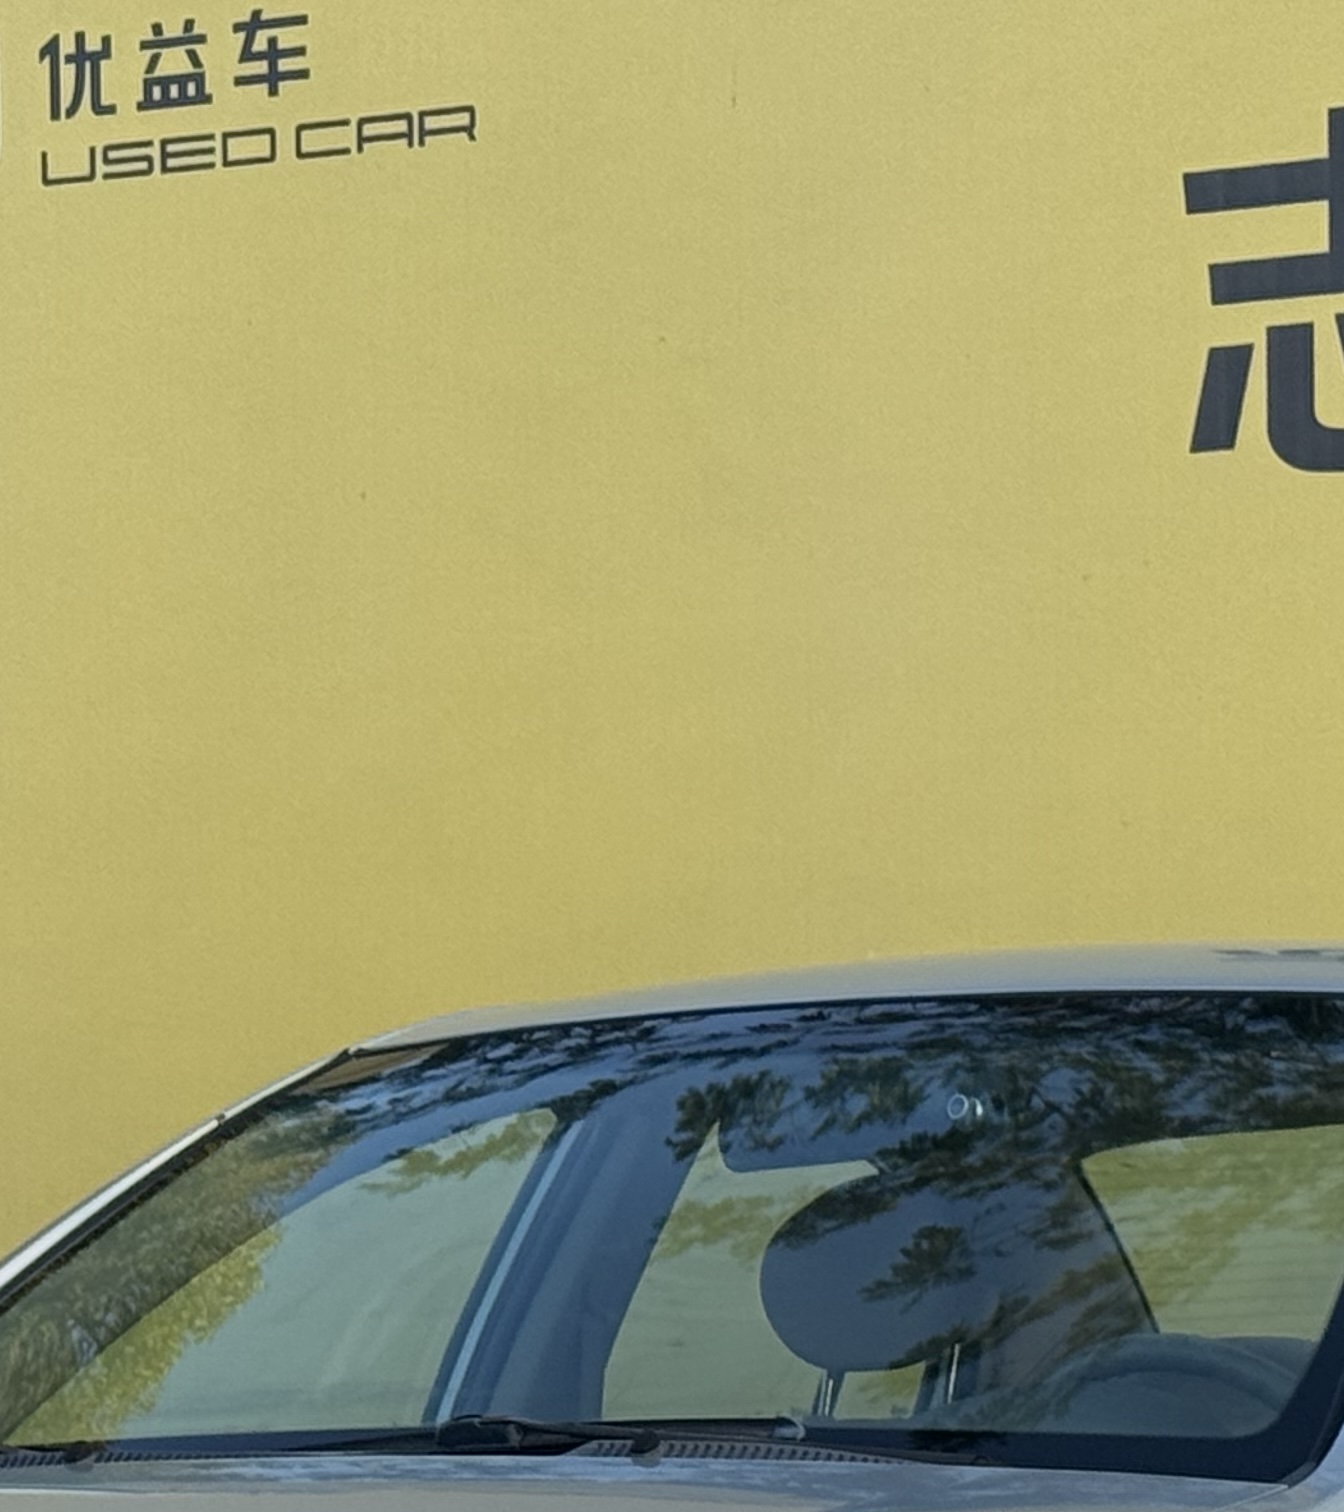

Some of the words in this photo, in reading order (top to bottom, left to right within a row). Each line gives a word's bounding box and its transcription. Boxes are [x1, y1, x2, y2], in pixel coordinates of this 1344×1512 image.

[38, 8, 311, 121] 优益车
[41, 127, 277, 187] USED
[295, 105, 478, 160] CAR
